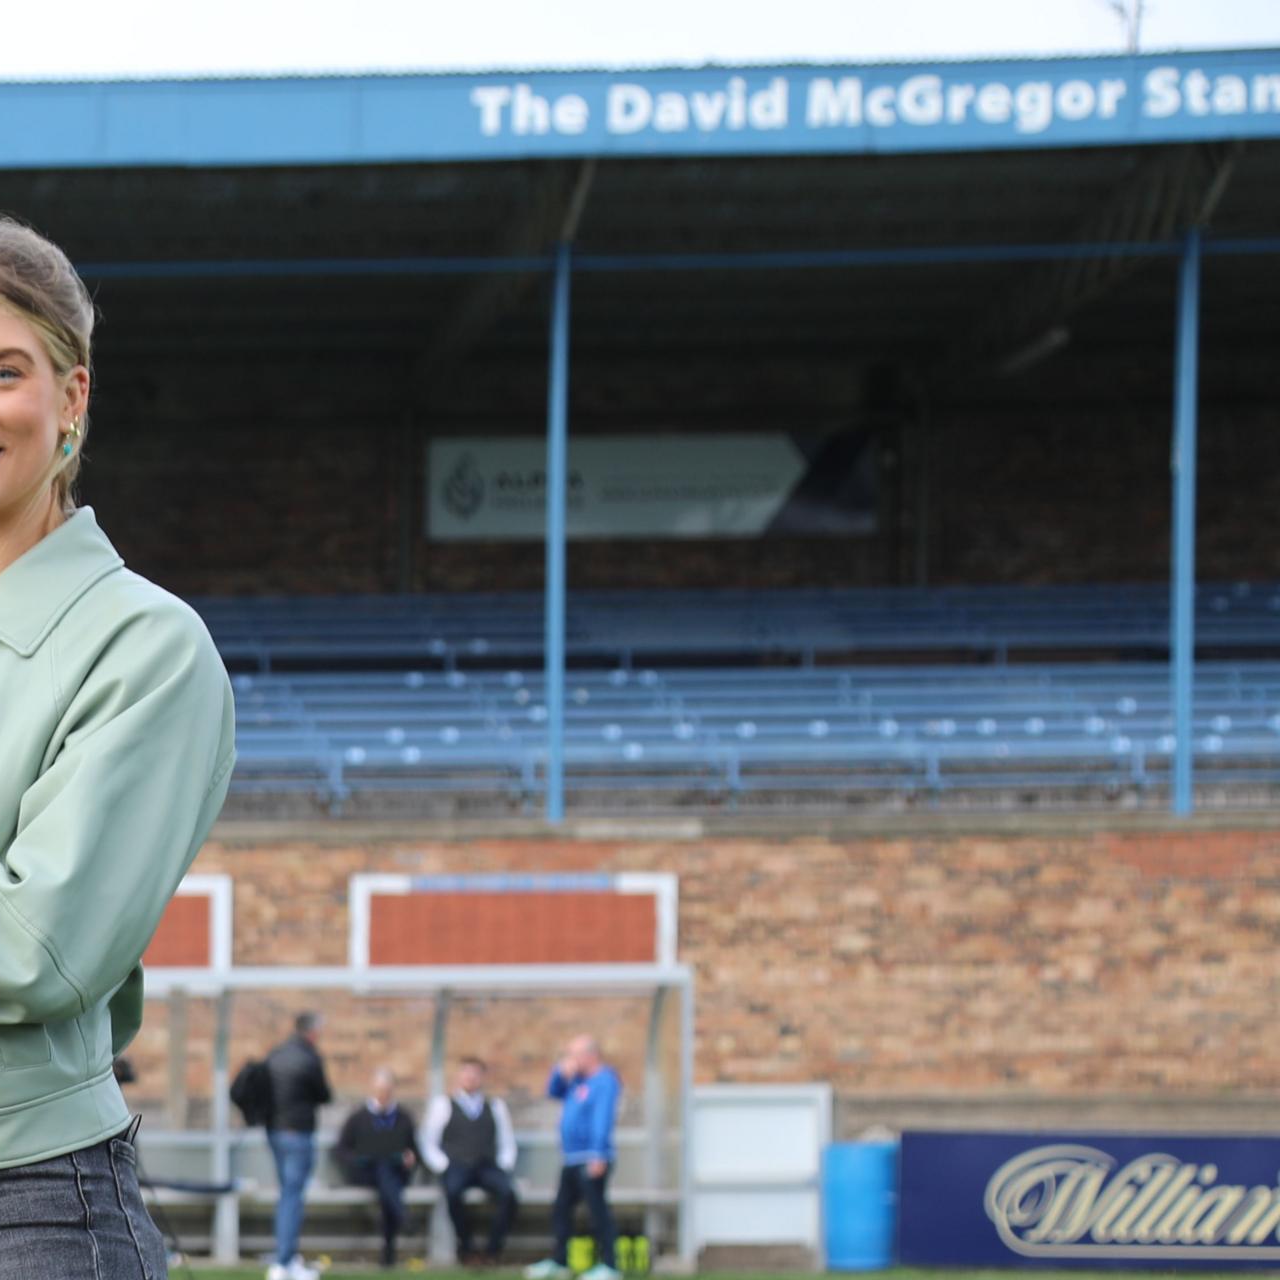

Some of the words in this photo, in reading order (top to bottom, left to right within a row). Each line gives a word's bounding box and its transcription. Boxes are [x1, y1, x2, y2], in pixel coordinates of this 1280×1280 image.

[471, 83, 589, 136] The
[606, 75, 790, 134] David
[806, 73, 1127, 134] McGregor
